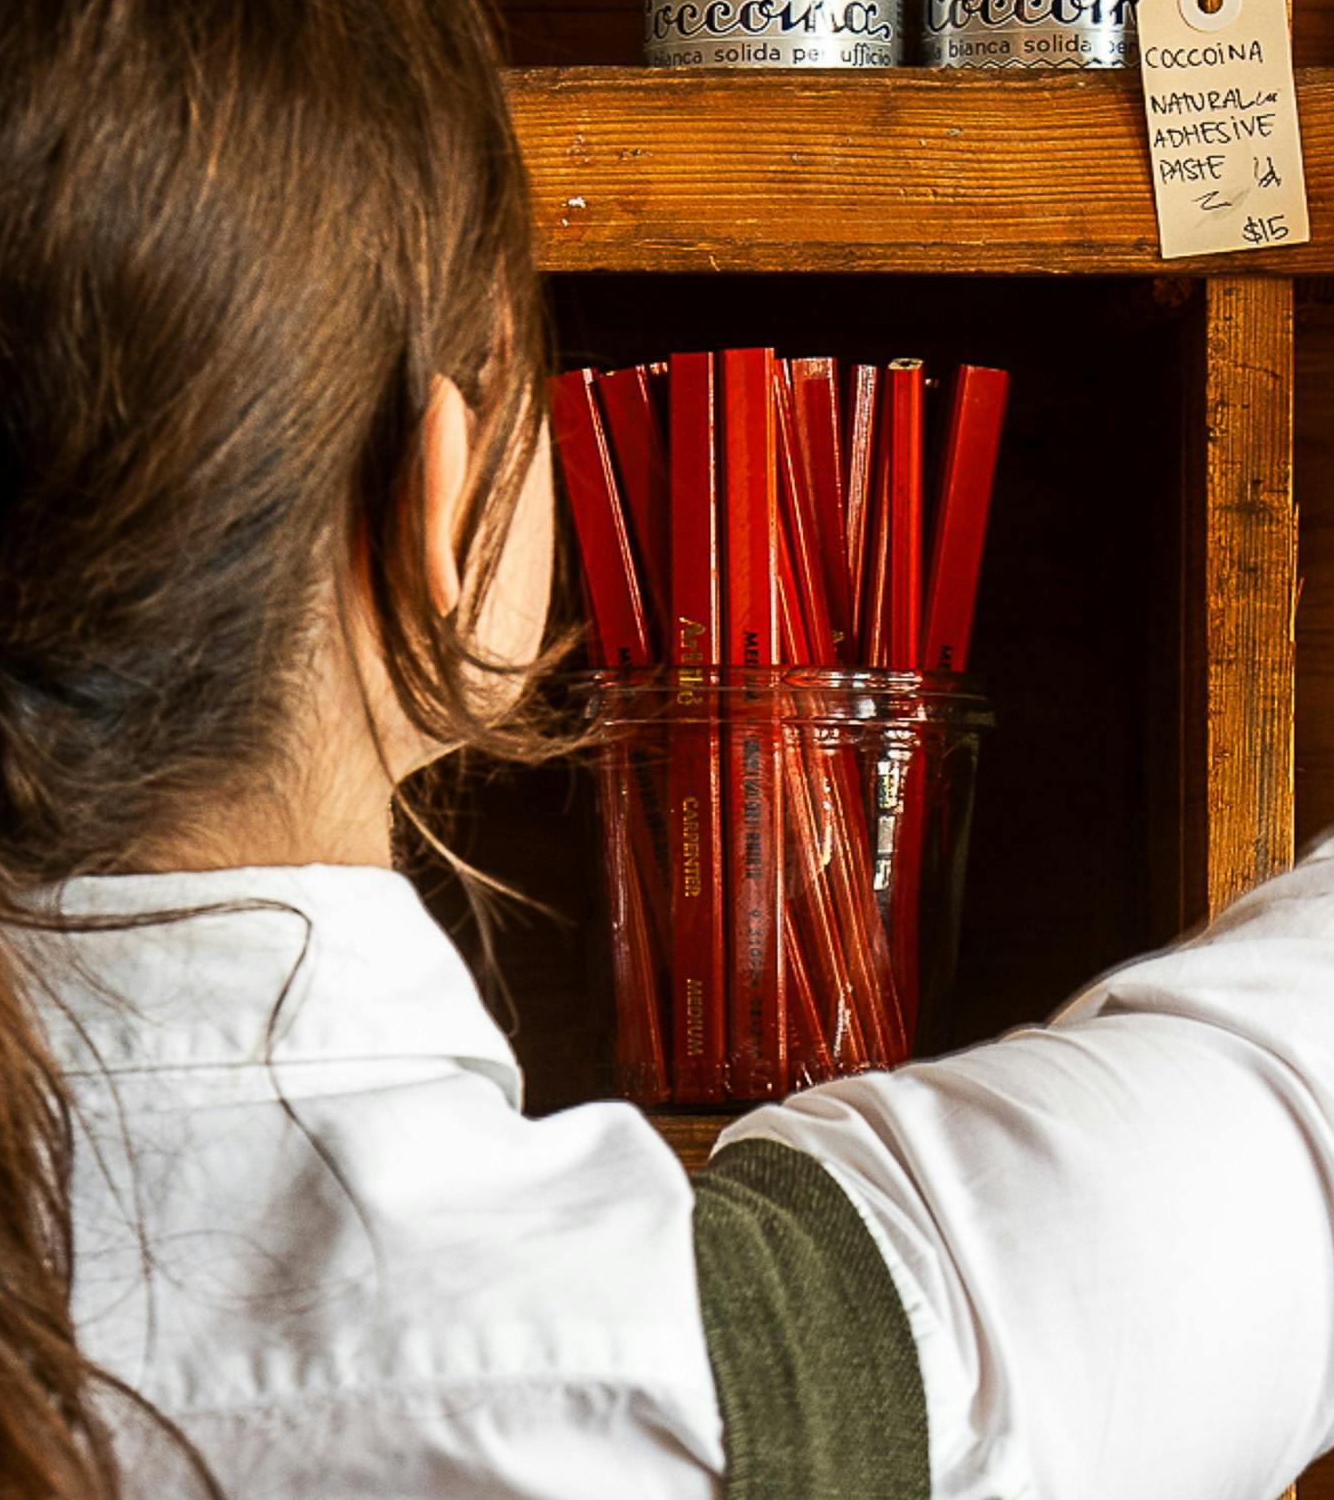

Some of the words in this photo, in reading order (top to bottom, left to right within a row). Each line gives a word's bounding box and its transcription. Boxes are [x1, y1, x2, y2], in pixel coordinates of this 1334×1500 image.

[715, 43, 781, 62] solida
[841, 43, 891, 67] ufficio
[949, 40, 1010, 57] bianca
[1024, 35, 1091, 54] solida
[1145, 40, 1263, 68] COCCOINA
[1153, 114, 1276, 149] ADHESIVE
[1160, 155, 1226, 184] PASTE
[1242, 215, 1290, 244] $15
[682, 797, 702, 897] CARPENTER
[687, 977, 704, 1056] MEDIUM
